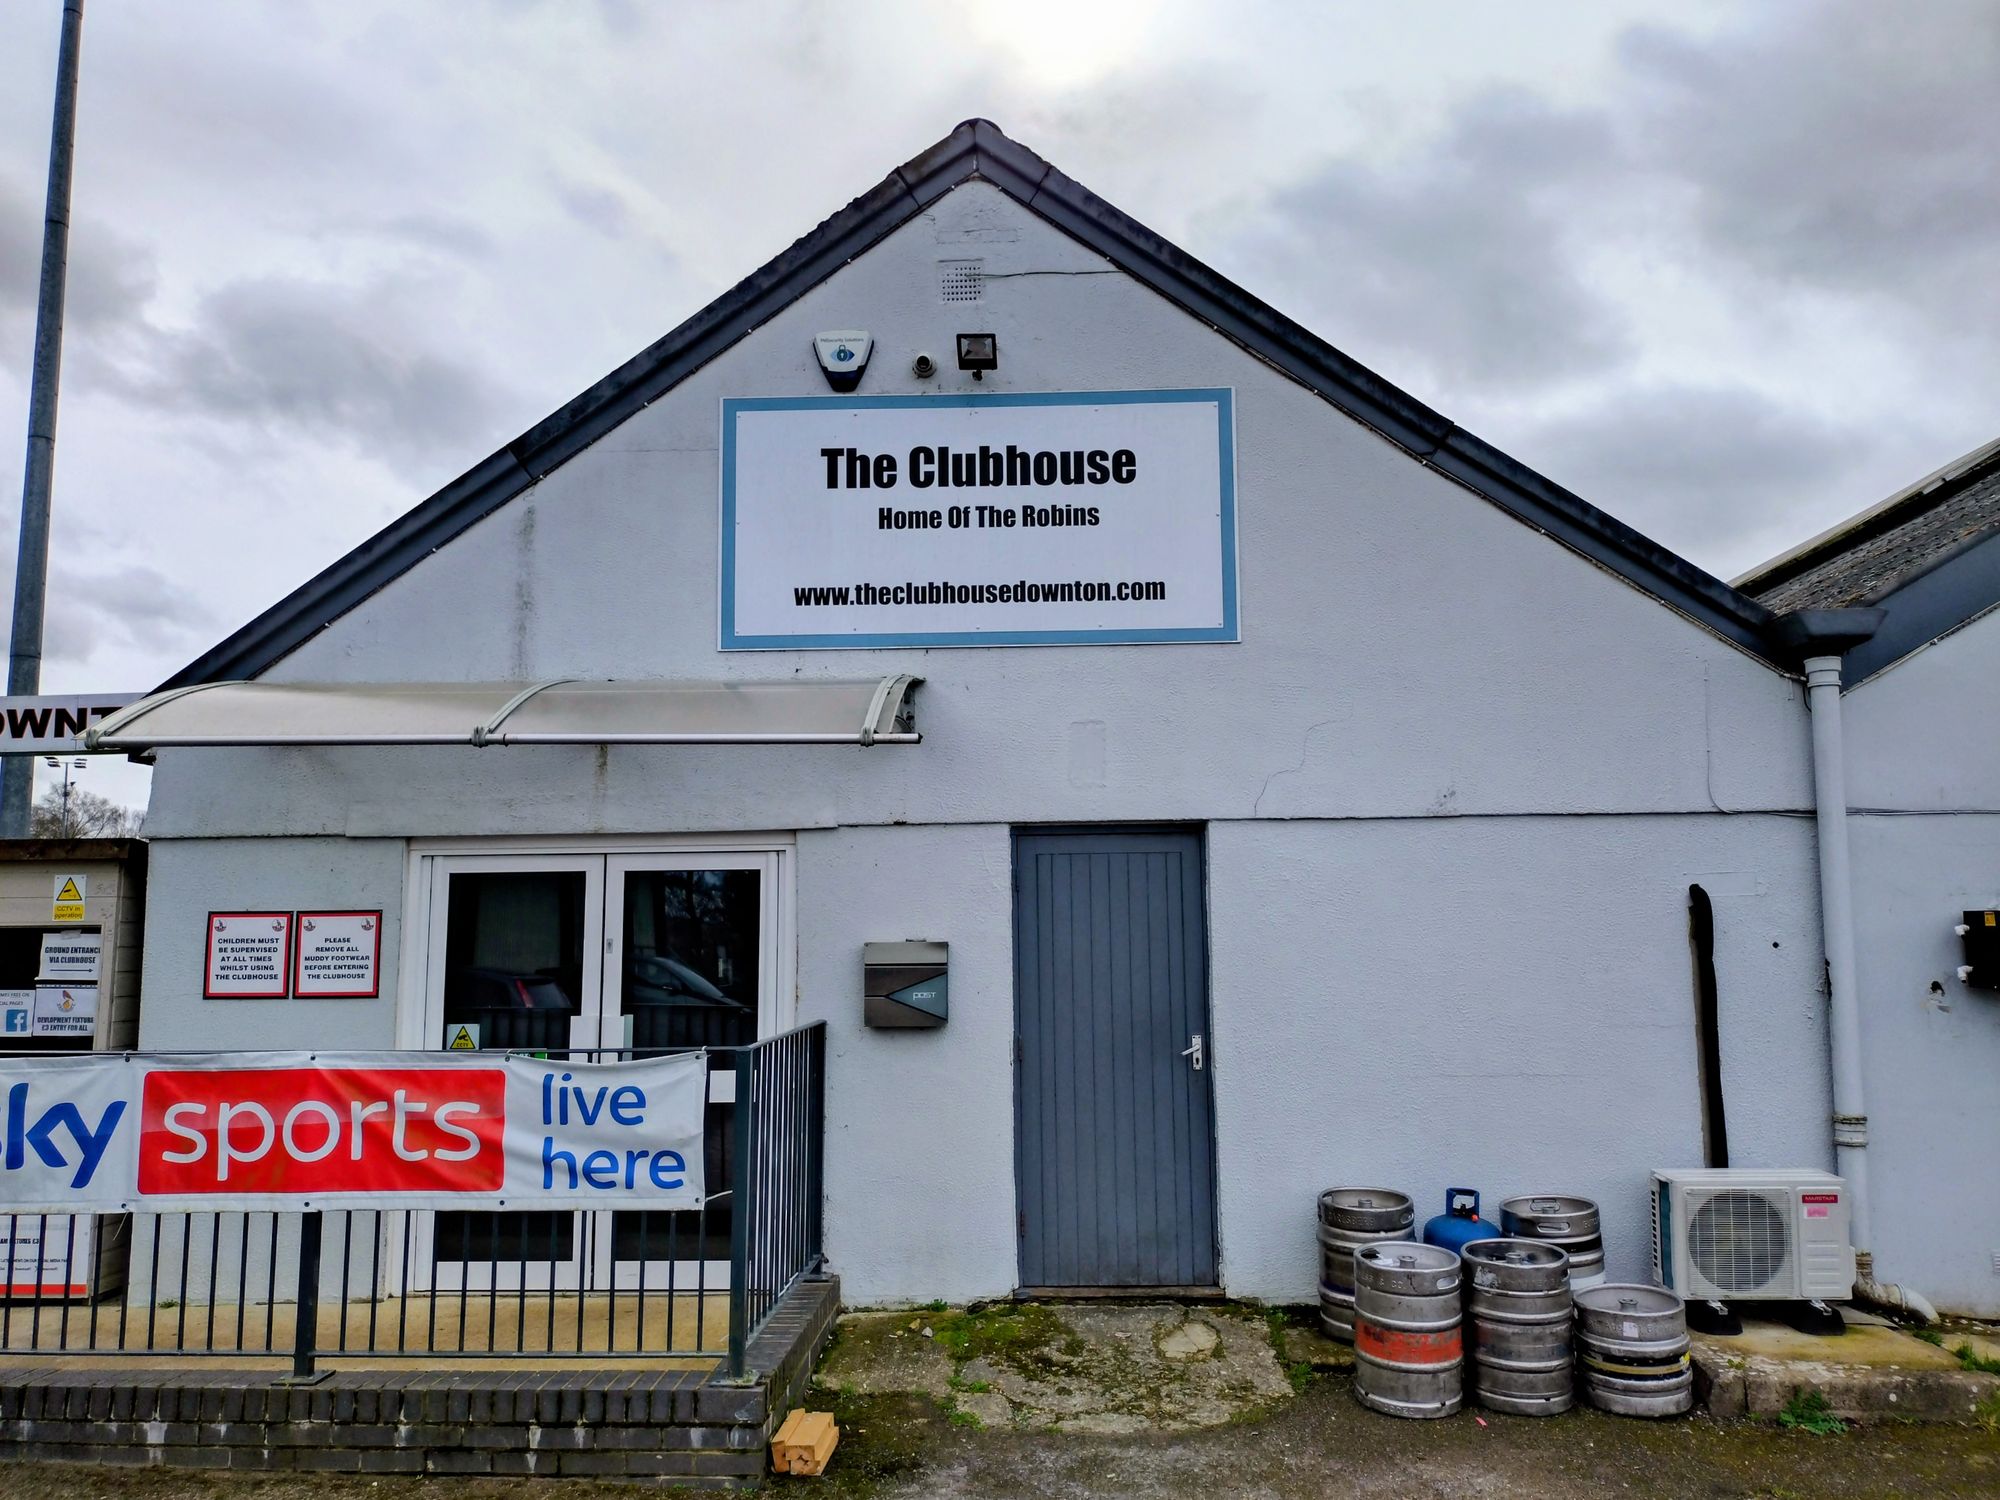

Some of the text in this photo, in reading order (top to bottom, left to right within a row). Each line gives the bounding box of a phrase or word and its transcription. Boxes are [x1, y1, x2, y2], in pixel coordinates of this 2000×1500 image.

[821, 444, 1137, 489] The Clubhouse
[878, 504, 1100, 530] Home Of The Robins
[794, 578, 1166, 606] www.theclubhousedownton.com
[54, 912, 83, 920] operation
[45, 946, 69, 954] GROUND
[542, 1073, 646, 1126] live
[0, 1082, 481, 1189] ky sports
[542, 1136, 686, 1190] here
